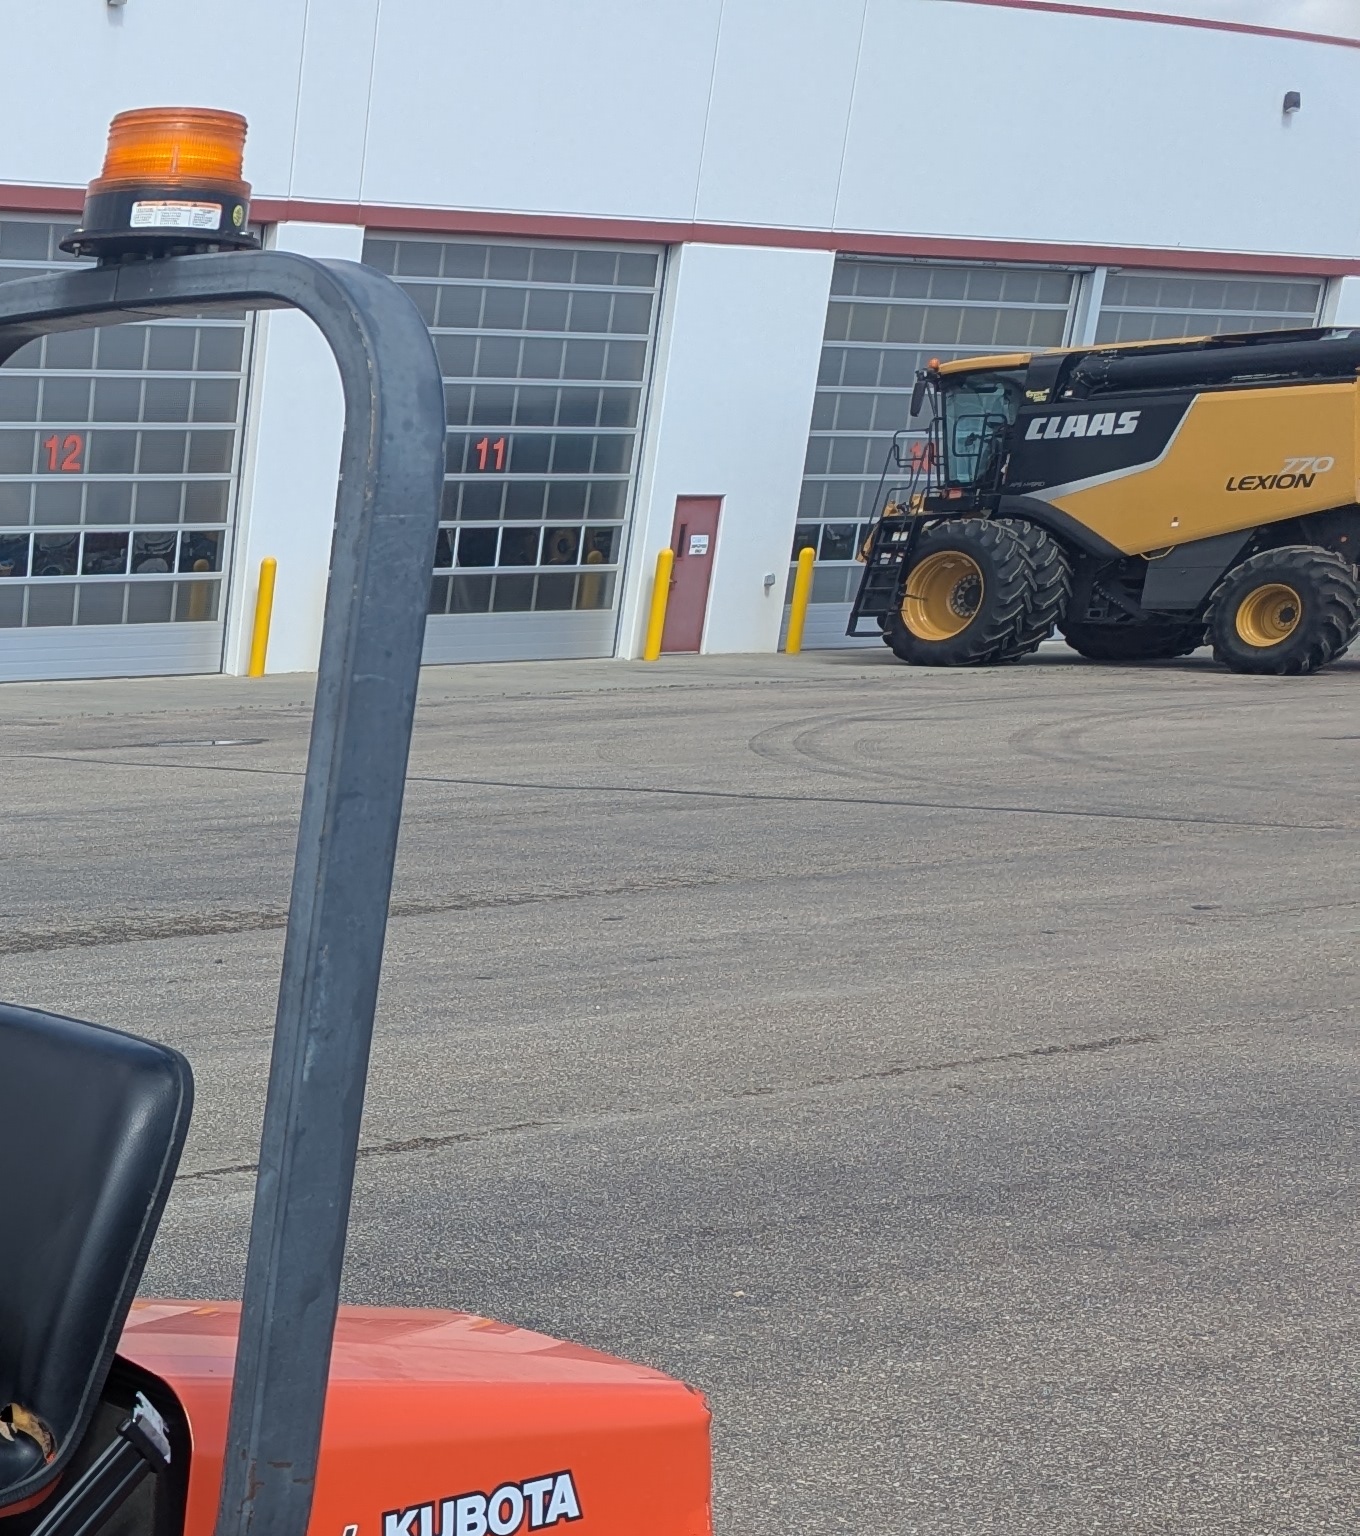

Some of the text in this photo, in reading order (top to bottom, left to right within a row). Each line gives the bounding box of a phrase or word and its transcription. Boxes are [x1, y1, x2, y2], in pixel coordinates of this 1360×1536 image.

[1024, 411, 1141, 440] CLAAS
[44, 434, 82, 471] 12
[475, 437, 505, 470] 11
[1280, 456, 1335, 474] 770
[1225, 472, 1317, 491] LEXION
